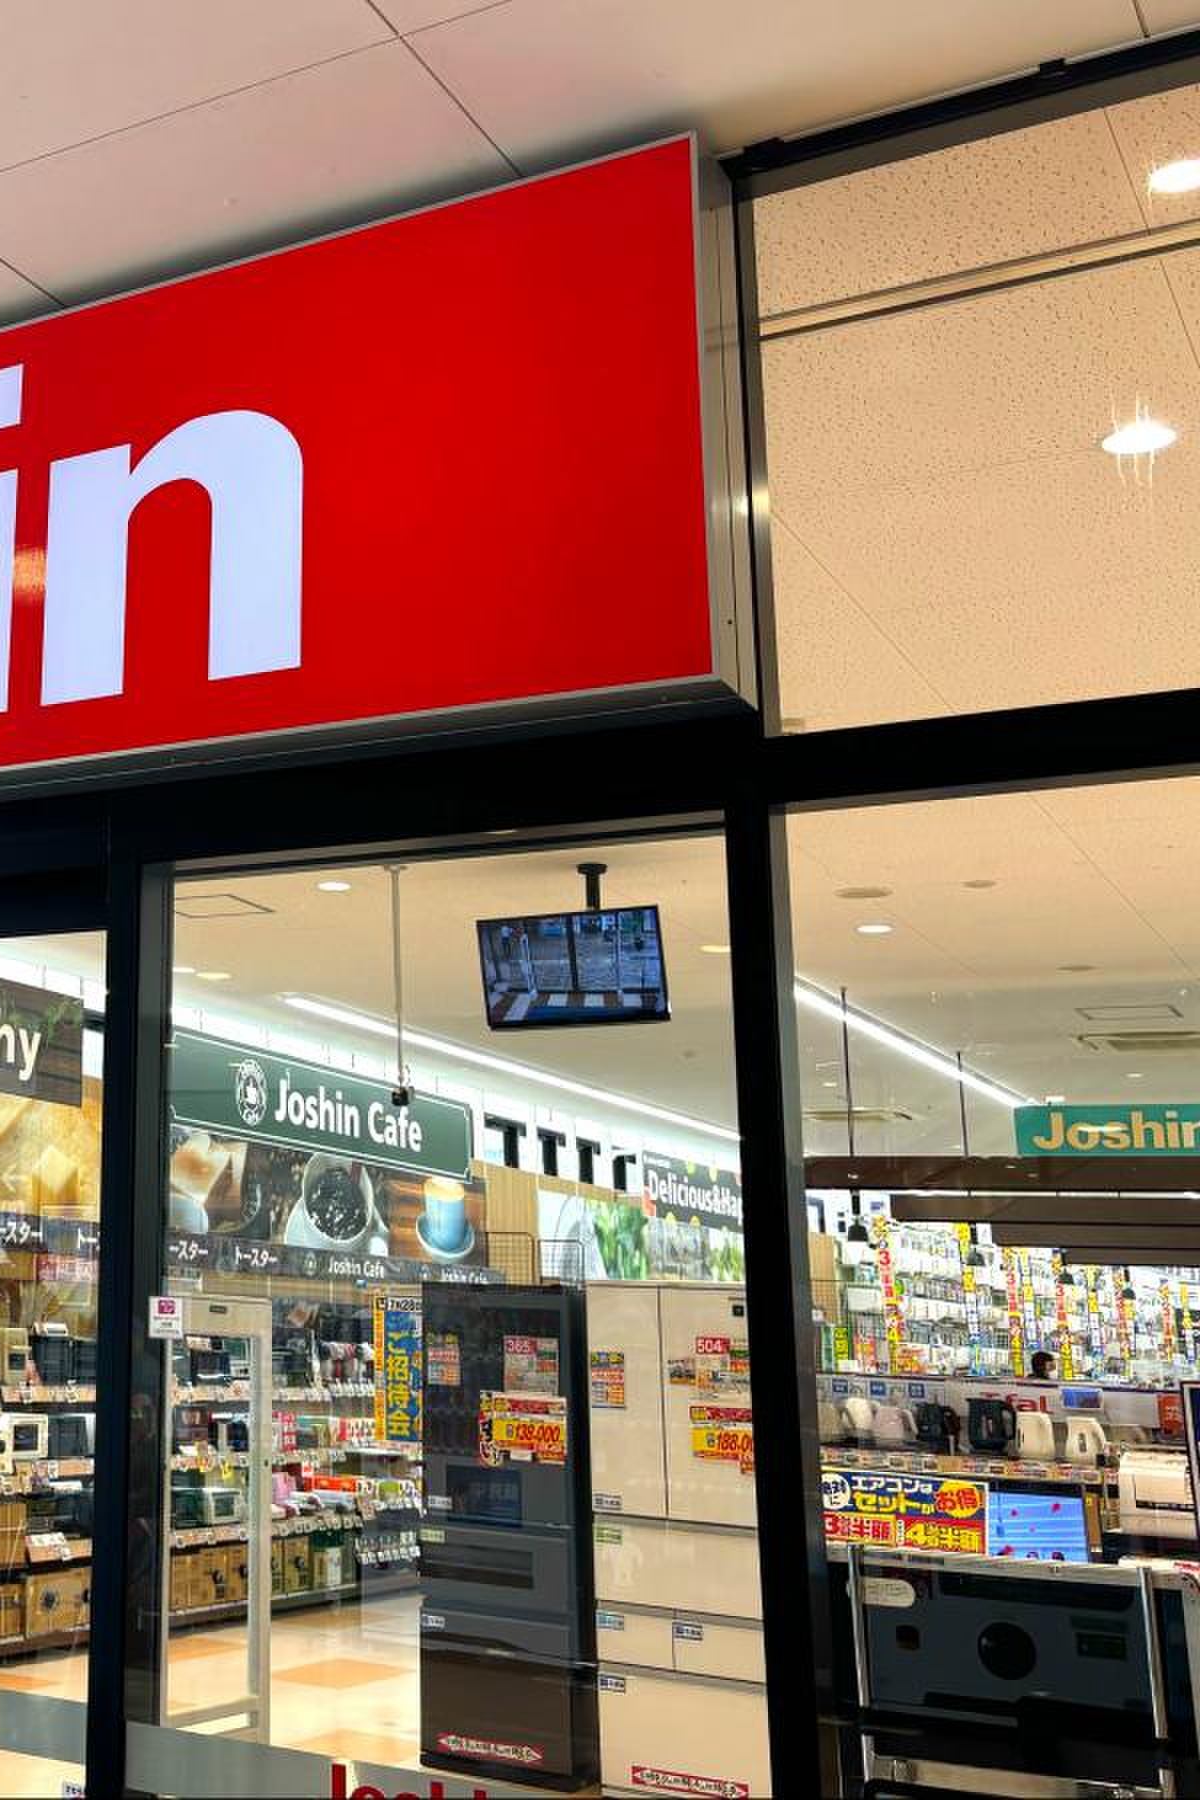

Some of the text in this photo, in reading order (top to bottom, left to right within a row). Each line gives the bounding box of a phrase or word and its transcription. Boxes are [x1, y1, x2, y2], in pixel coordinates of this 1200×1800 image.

[274, 1078, 422, 1152] Joshin Cafe
[235, 1246, 278, 1267] トースター
[328, 1256, 386, 1279] Joshin Cafe
